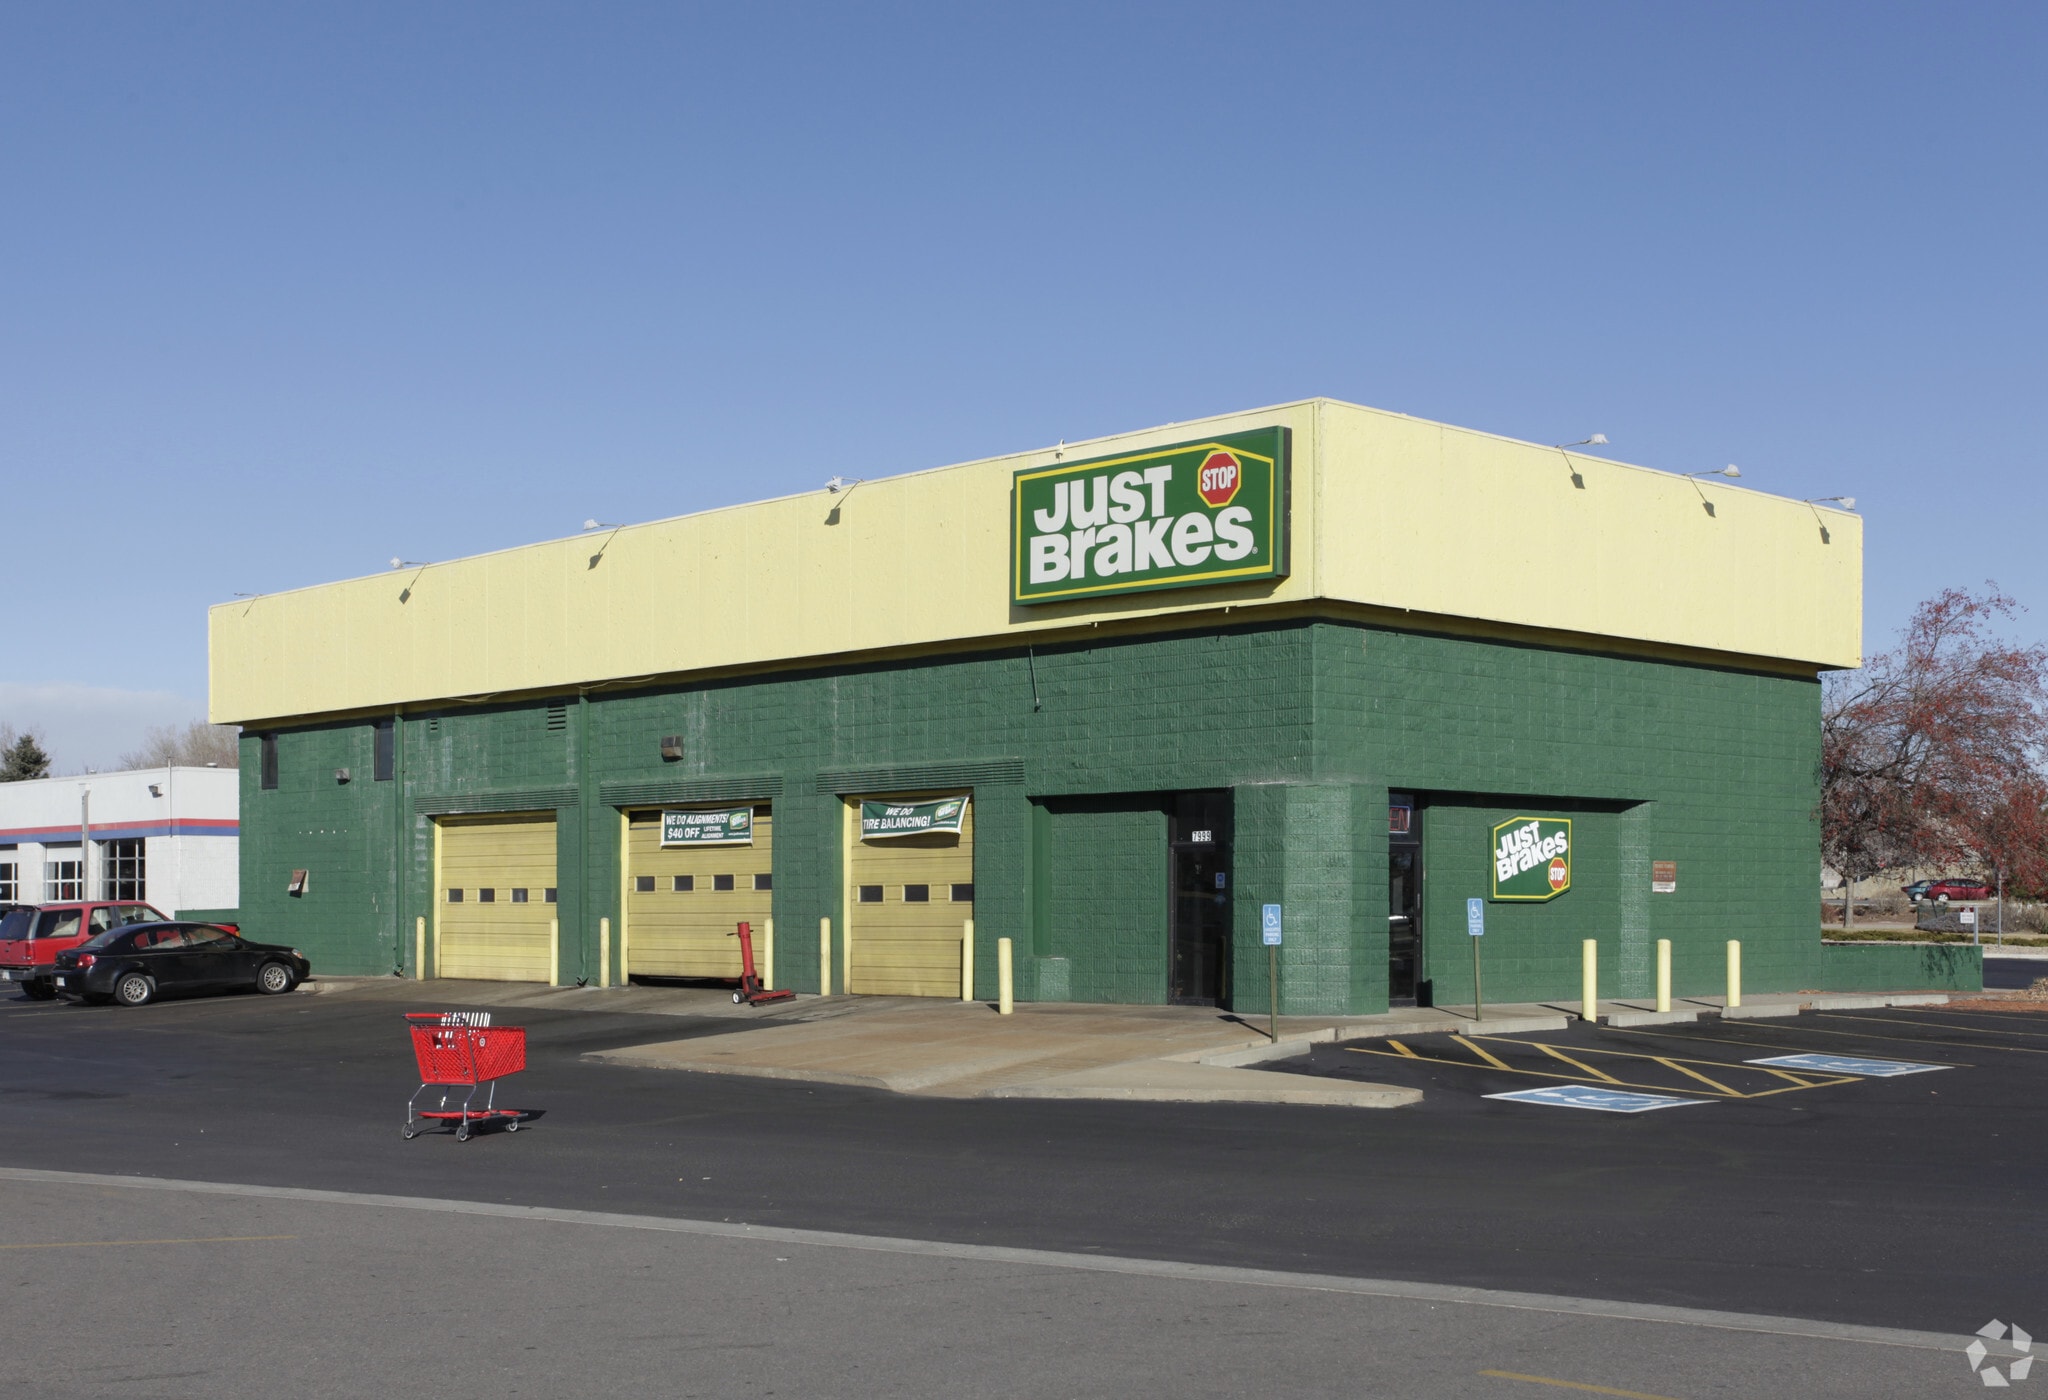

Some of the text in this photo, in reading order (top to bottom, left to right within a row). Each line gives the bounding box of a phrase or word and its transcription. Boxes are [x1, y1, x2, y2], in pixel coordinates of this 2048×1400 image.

[1202, 465, 1237, 492] STOP
[885, 807, 914, 816] WE DO
[666, 815, 676, 825] WE
[676, 815, 686, 825] DO
[686, 813, 730, 825] ALIGNMENTS!
[863, 815, 931, 830] TIRE BALANCING!
[1389, 807, 1408, 831] EN
[667, 827, 701, 839] $40 OFF
[1550, 867, 1566, 881] STOP
